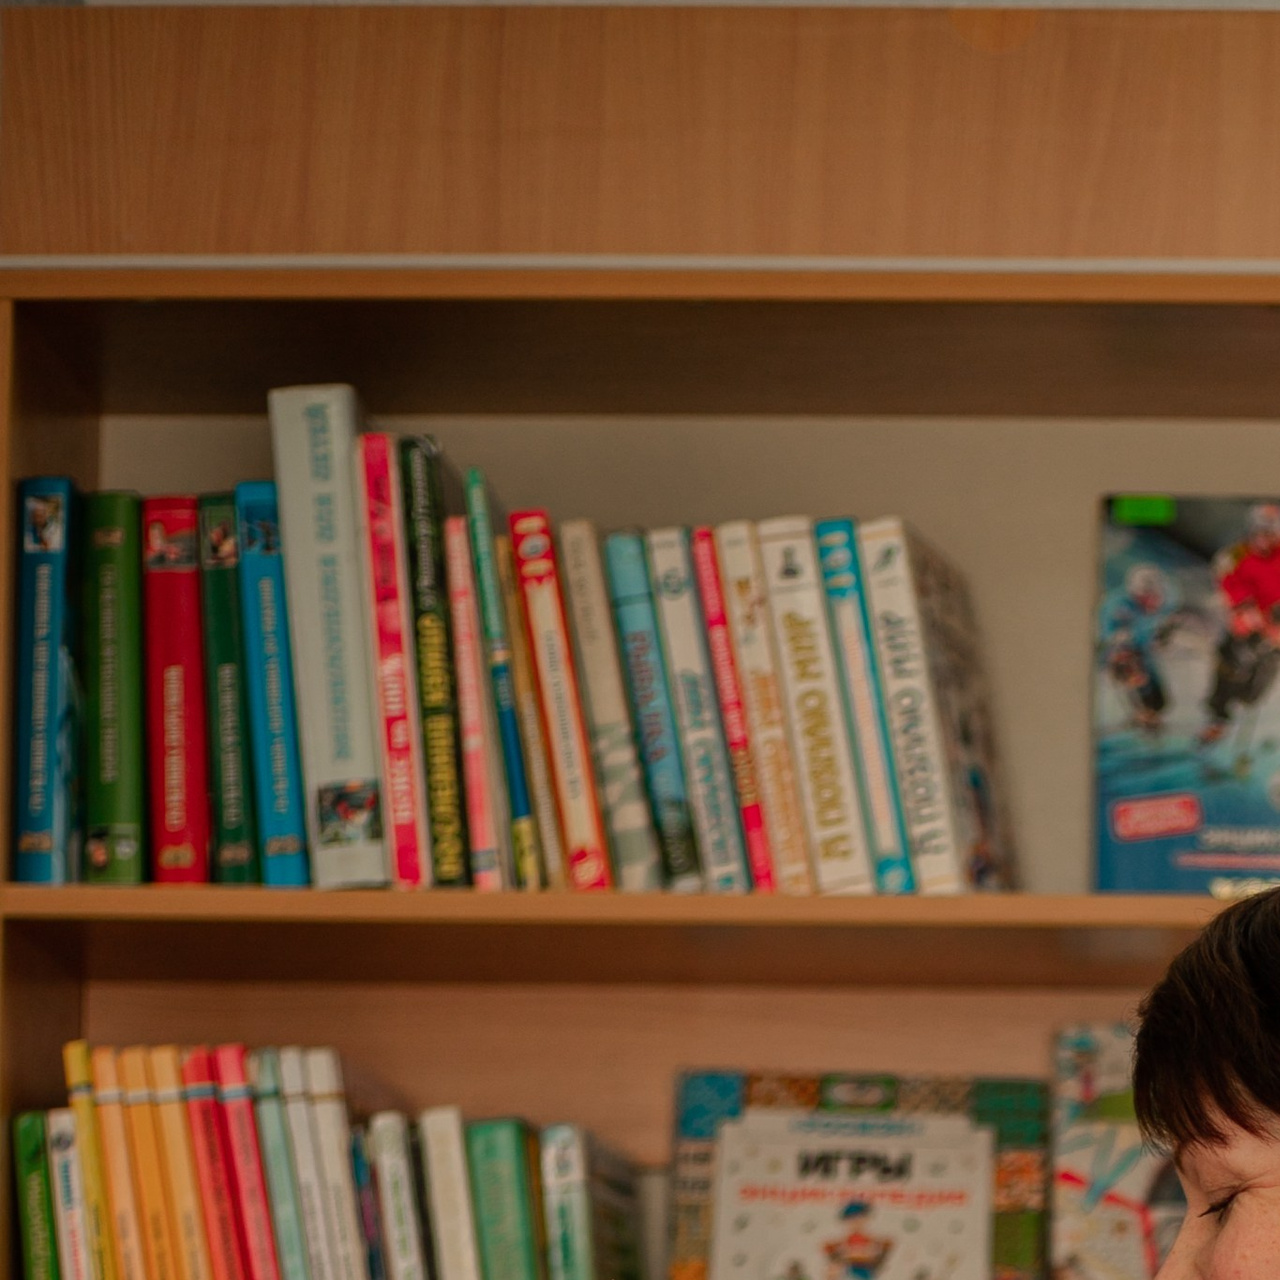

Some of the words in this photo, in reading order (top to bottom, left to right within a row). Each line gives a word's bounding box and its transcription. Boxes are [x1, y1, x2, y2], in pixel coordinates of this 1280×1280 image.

[783, 611, 821, 683] МИР
[880, 612, 918, 685] МИР
[796, 690, 843, 828] ПОЗНАЮ
[894, 690, 940, 827] ПОЗНАЮ
[797, 1150, 914, 1180] ИГРЫ
